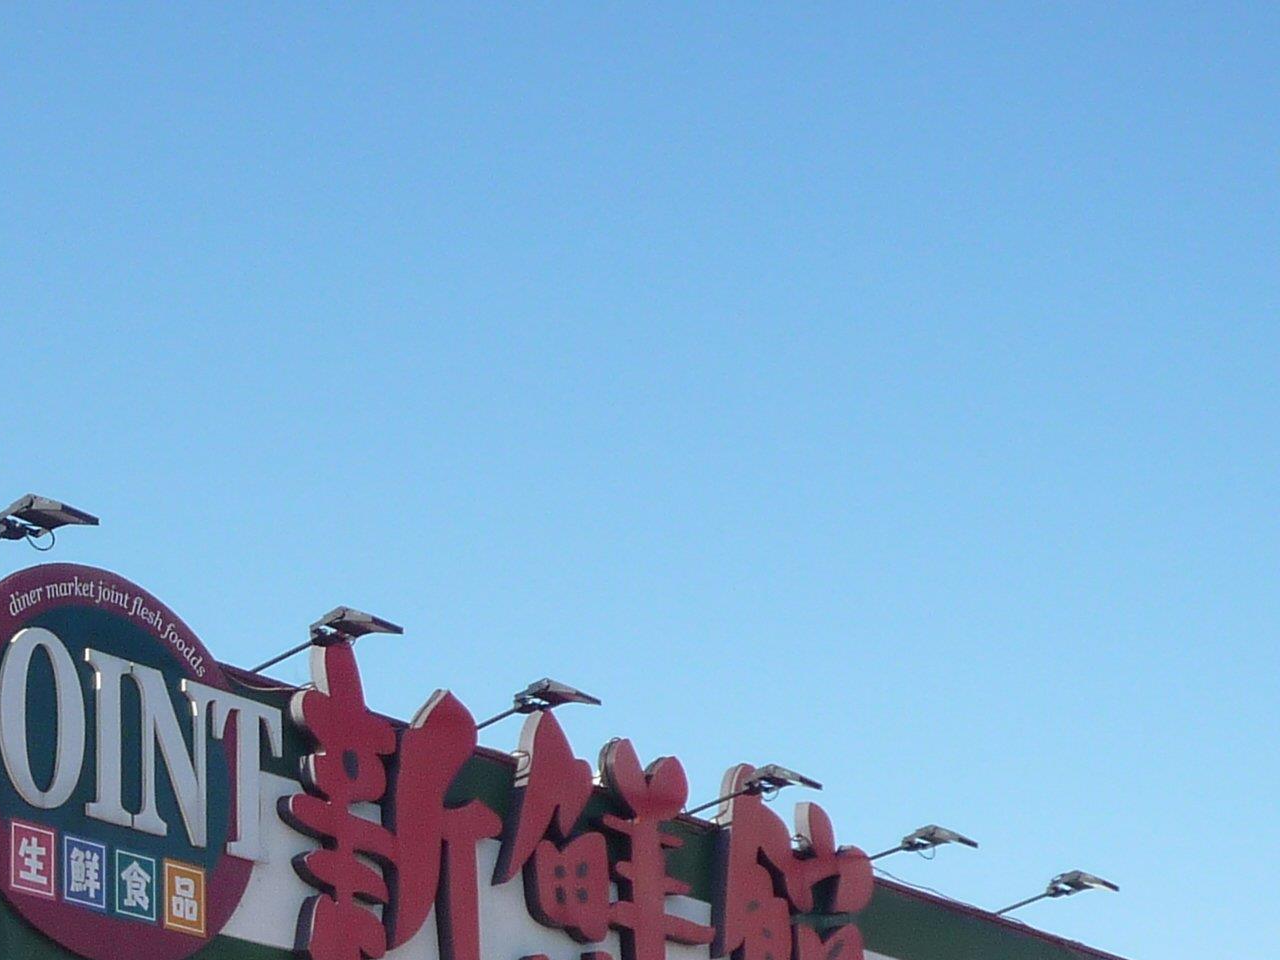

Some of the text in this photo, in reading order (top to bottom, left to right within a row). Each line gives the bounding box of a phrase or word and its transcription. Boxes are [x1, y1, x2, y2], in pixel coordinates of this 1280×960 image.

[9, 586, 43, 616] diner
[46, 576, 95, 599] market
[96, 580, 131, 609] joint
[129, 596, 163, 632] flesh
[18, 836, 198, 921] 生鮮食品
